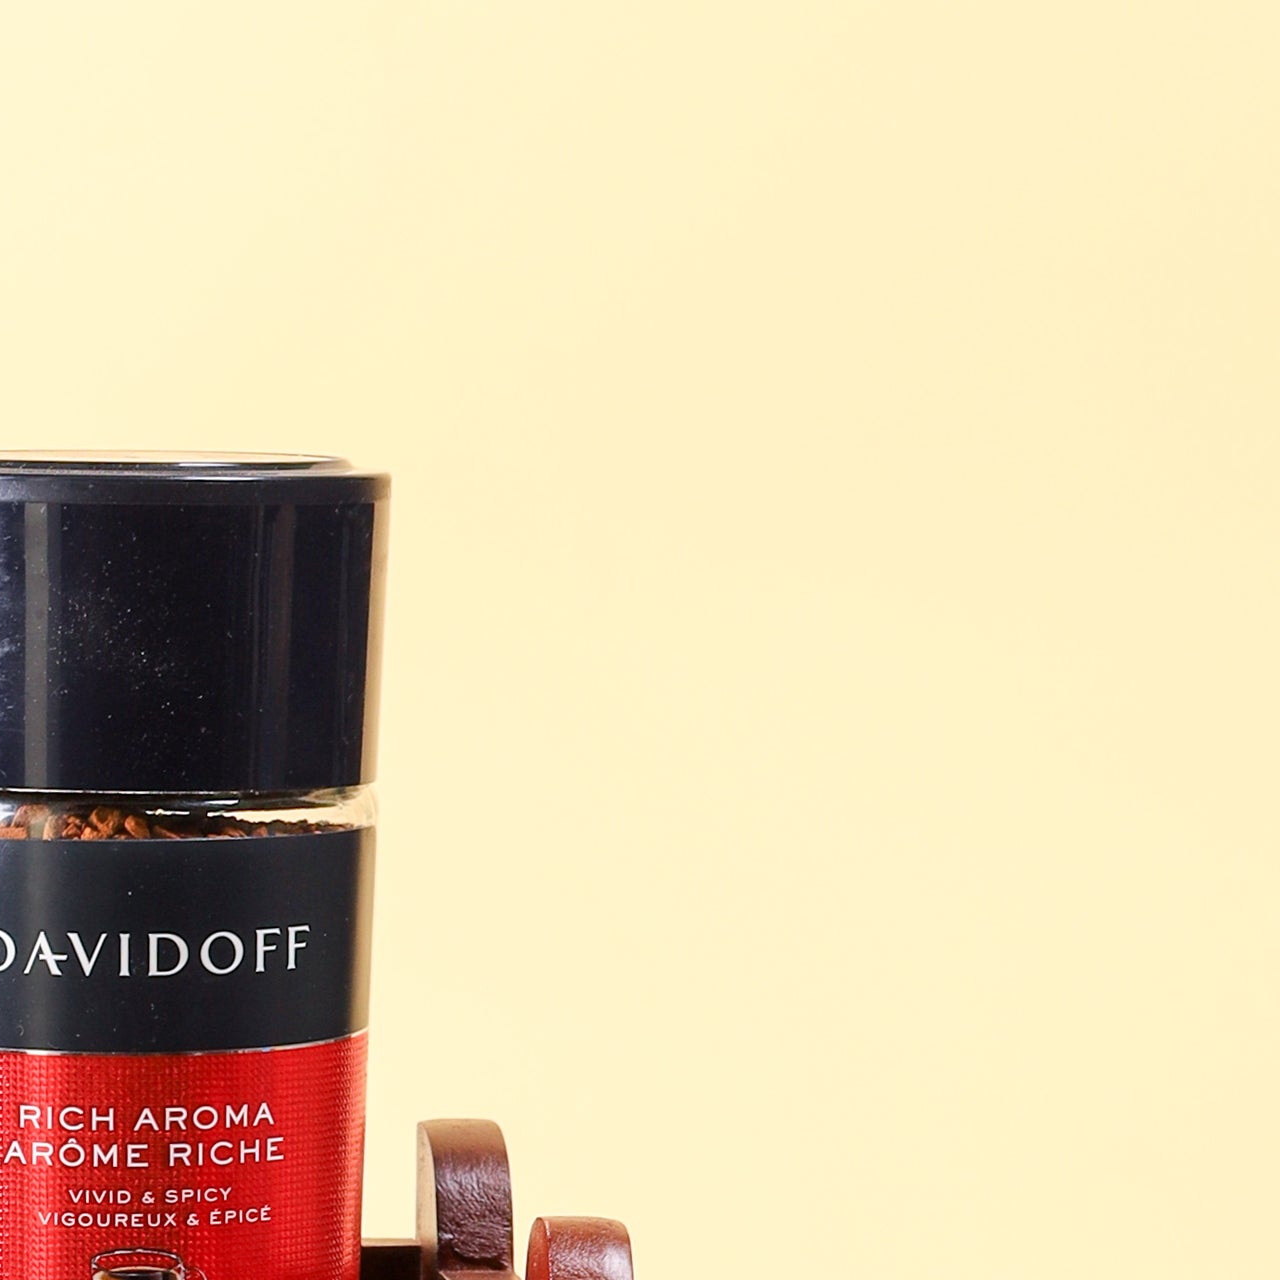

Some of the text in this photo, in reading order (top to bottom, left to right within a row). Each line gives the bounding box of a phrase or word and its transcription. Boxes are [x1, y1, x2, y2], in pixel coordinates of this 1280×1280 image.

[19, 1102, 275, 1132] RICH AROMA
[3, 1136, 285, 1167] ARÔME RICHE
[69, 1186, 233, 1204] VIVID & SPICY
[38, 1205, 272, 1228] VIGOUREUX & ÉPICÉ
